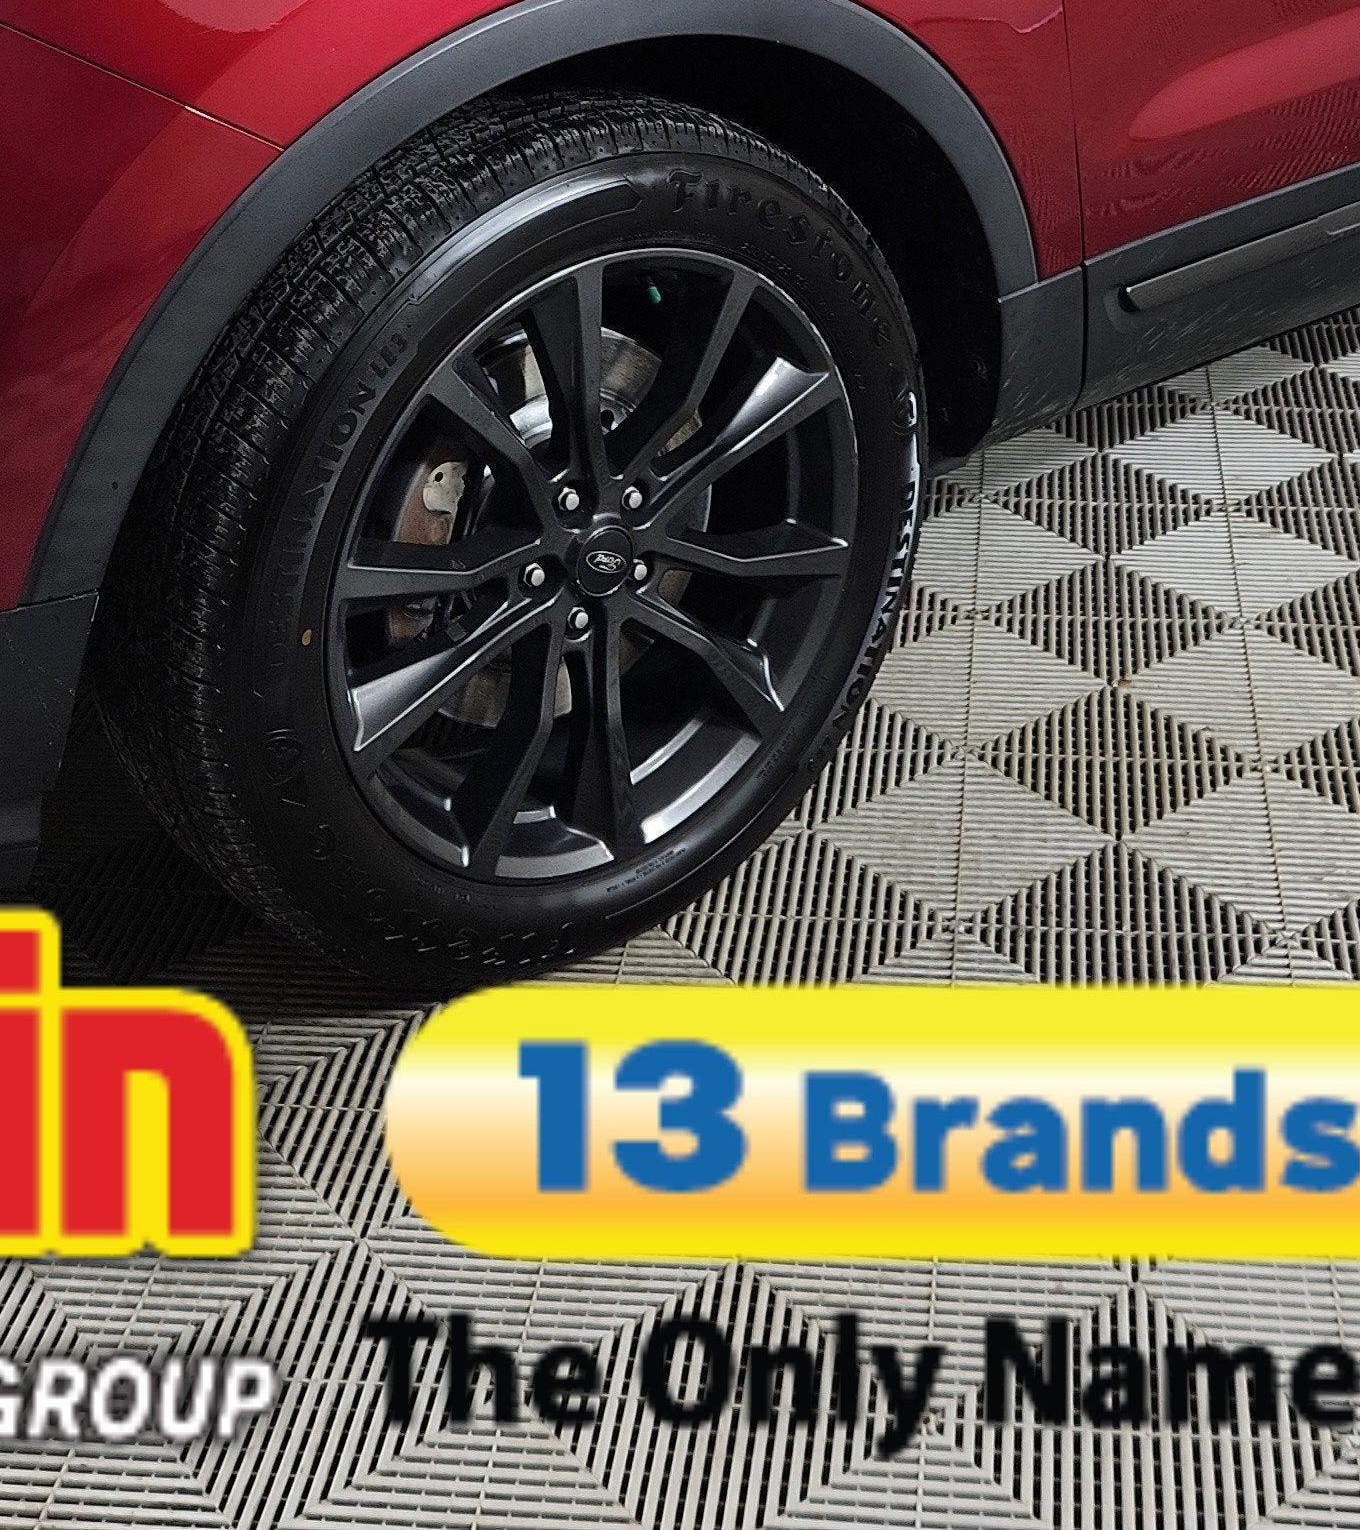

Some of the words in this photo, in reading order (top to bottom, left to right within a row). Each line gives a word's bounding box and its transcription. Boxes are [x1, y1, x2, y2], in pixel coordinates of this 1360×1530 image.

[667, 167, 895, 351] Firestone
[591, 553, 623, 572] Ford
[830, 481, 916, 725] DESTINATION
